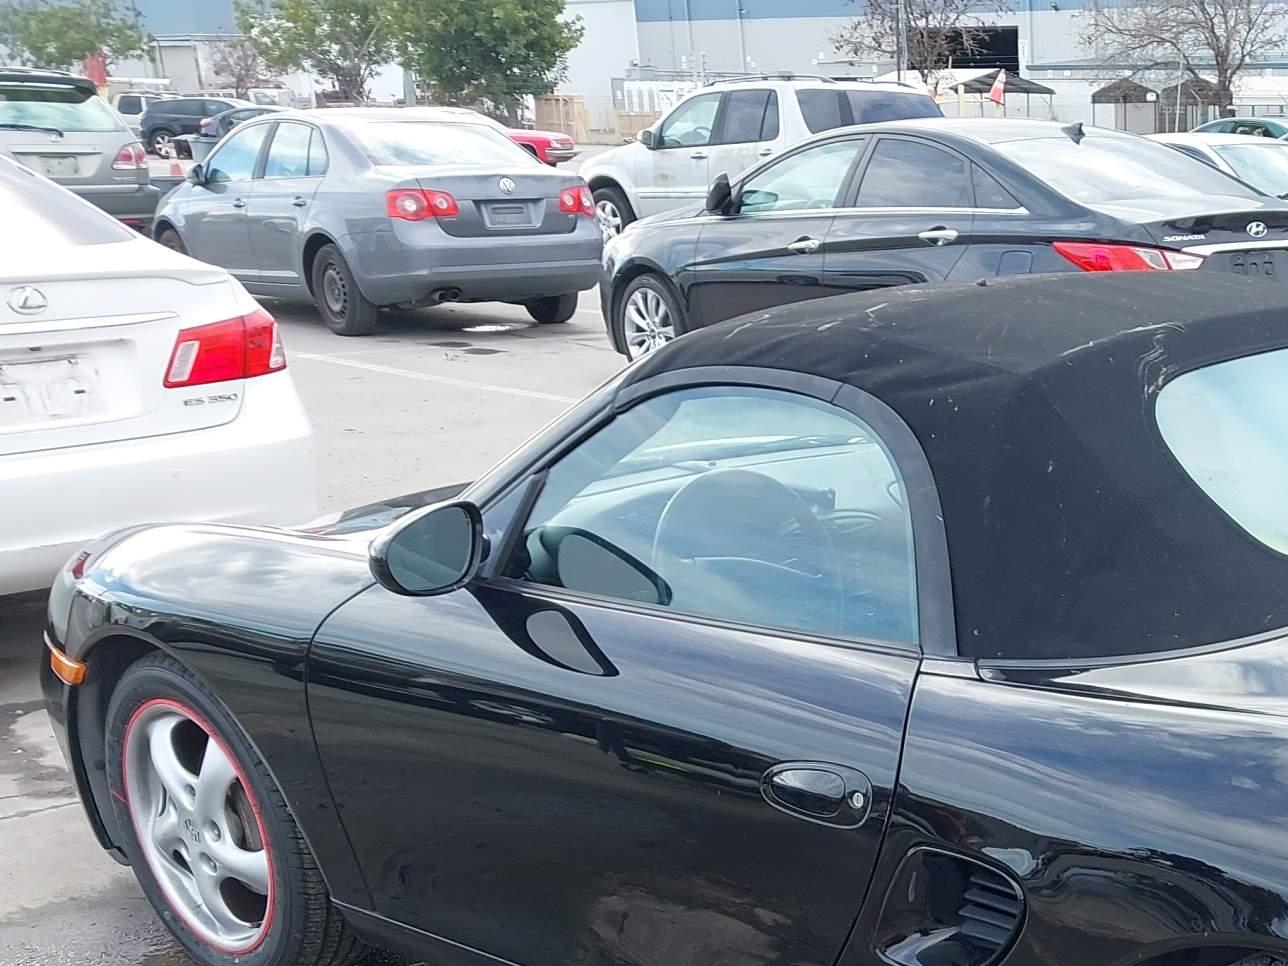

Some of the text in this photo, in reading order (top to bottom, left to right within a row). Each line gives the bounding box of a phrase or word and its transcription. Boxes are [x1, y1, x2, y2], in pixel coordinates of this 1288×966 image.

[1162, 233, 1206, 242] SONATA
[183, 392, 238, 406] ES 350
